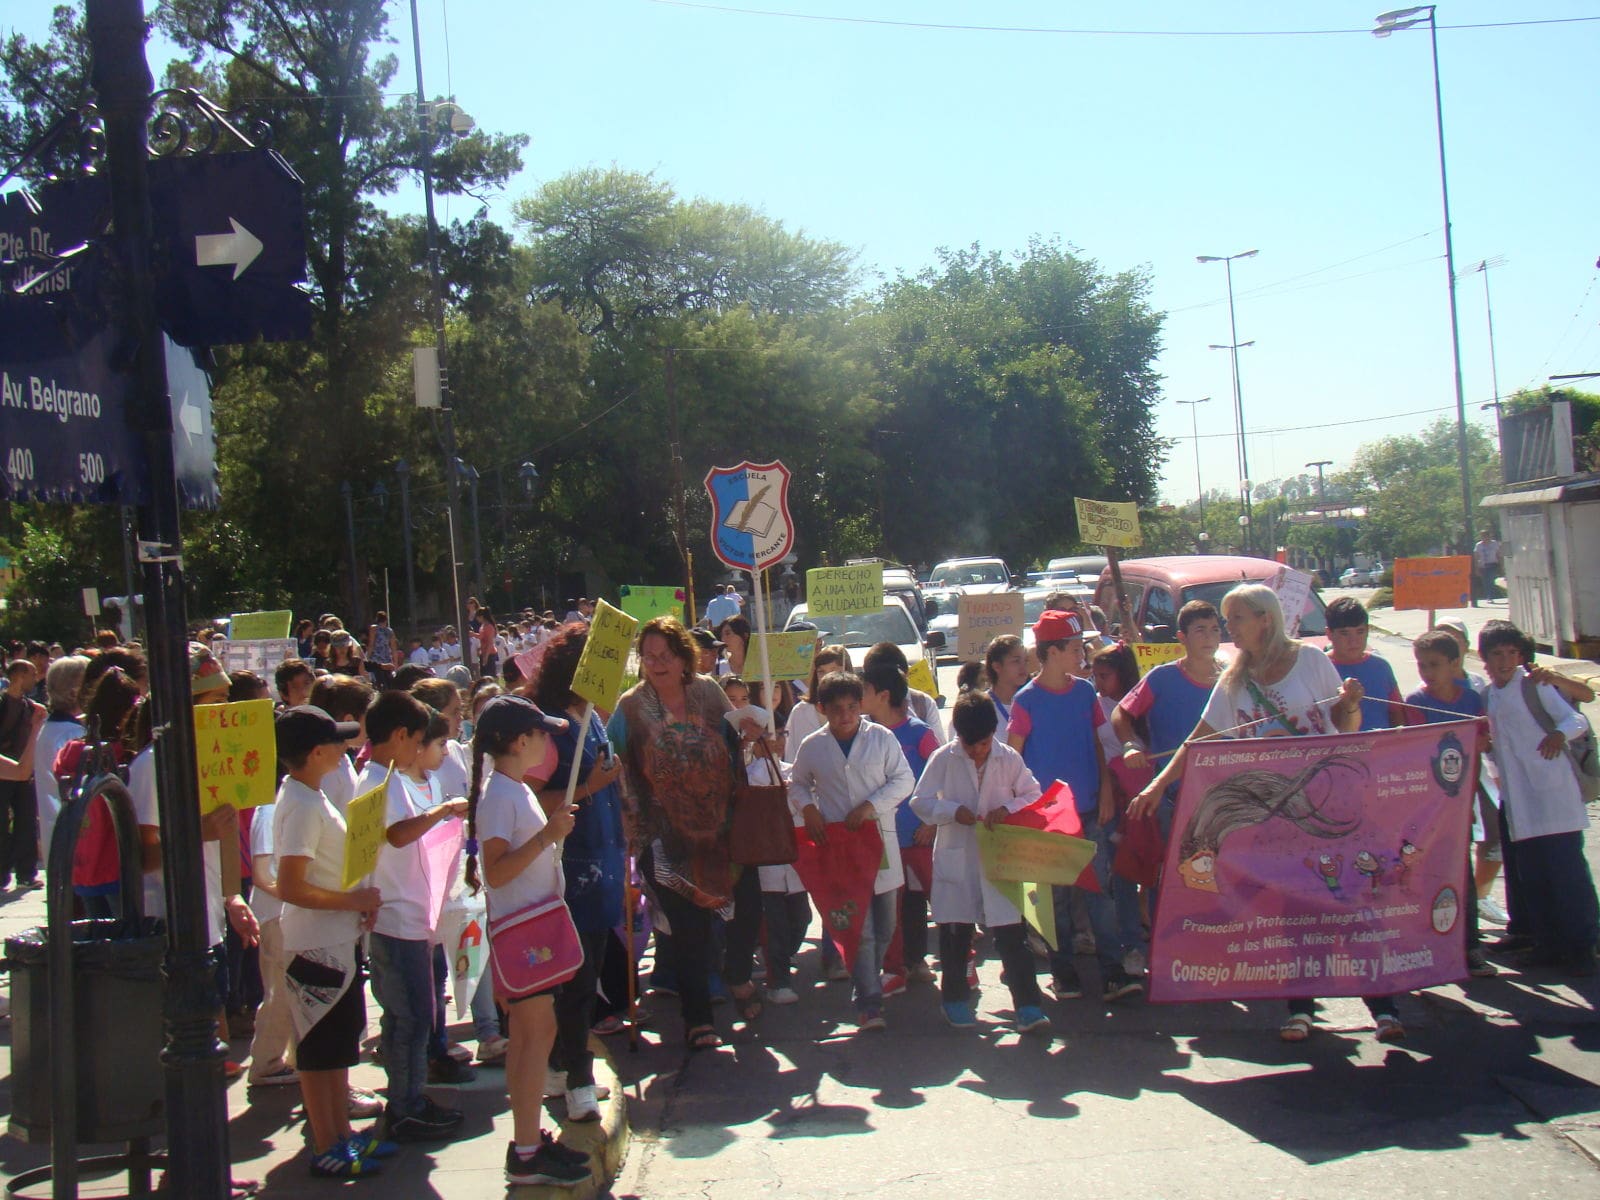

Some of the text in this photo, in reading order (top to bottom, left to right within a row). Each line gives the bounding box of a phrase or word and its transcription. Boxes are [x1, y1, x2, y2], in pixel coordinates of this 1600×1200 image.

[0, 227, 54, 260] Pte. Dr.
[2, 371, 101, 423] Av. Belgrano
[8, 447, 105, 484] 400 500
[727, 472, 767, 485] ESCUELA
[748, 532, 786, 560] MERCANTE
[816, 569, 872, 581] DERECHO
[812, 585, 822, 597] A
[813, 595, 881, 613] SALUDABLE
[196, 709, 258, 730] ERECHO
[201, 757, 235, 779] UGAR
[1195, 752, 1216, 767] Las
[1218, 750, 1256, 766] mismas
[1182, 918, 1244, 934] Promoción
[1246, 920, 1254, 933] y
[1255, 914, 1317, 929] Protección
[1226, 941, 1240, 954] de
[1263, 934, 1298, 950] Niñas,
[1302, 932, 1337, 946] Niños
[1338, 933, 1347, 947] y
[1171, 959, 1231, 987] Consejo
[1232, 956, 1302, 985] Municipal
[1303, 955, 1322, 979] de
[1325, 953, 1368, 978] Niñez
[1369, 957, 1380, 983] y
